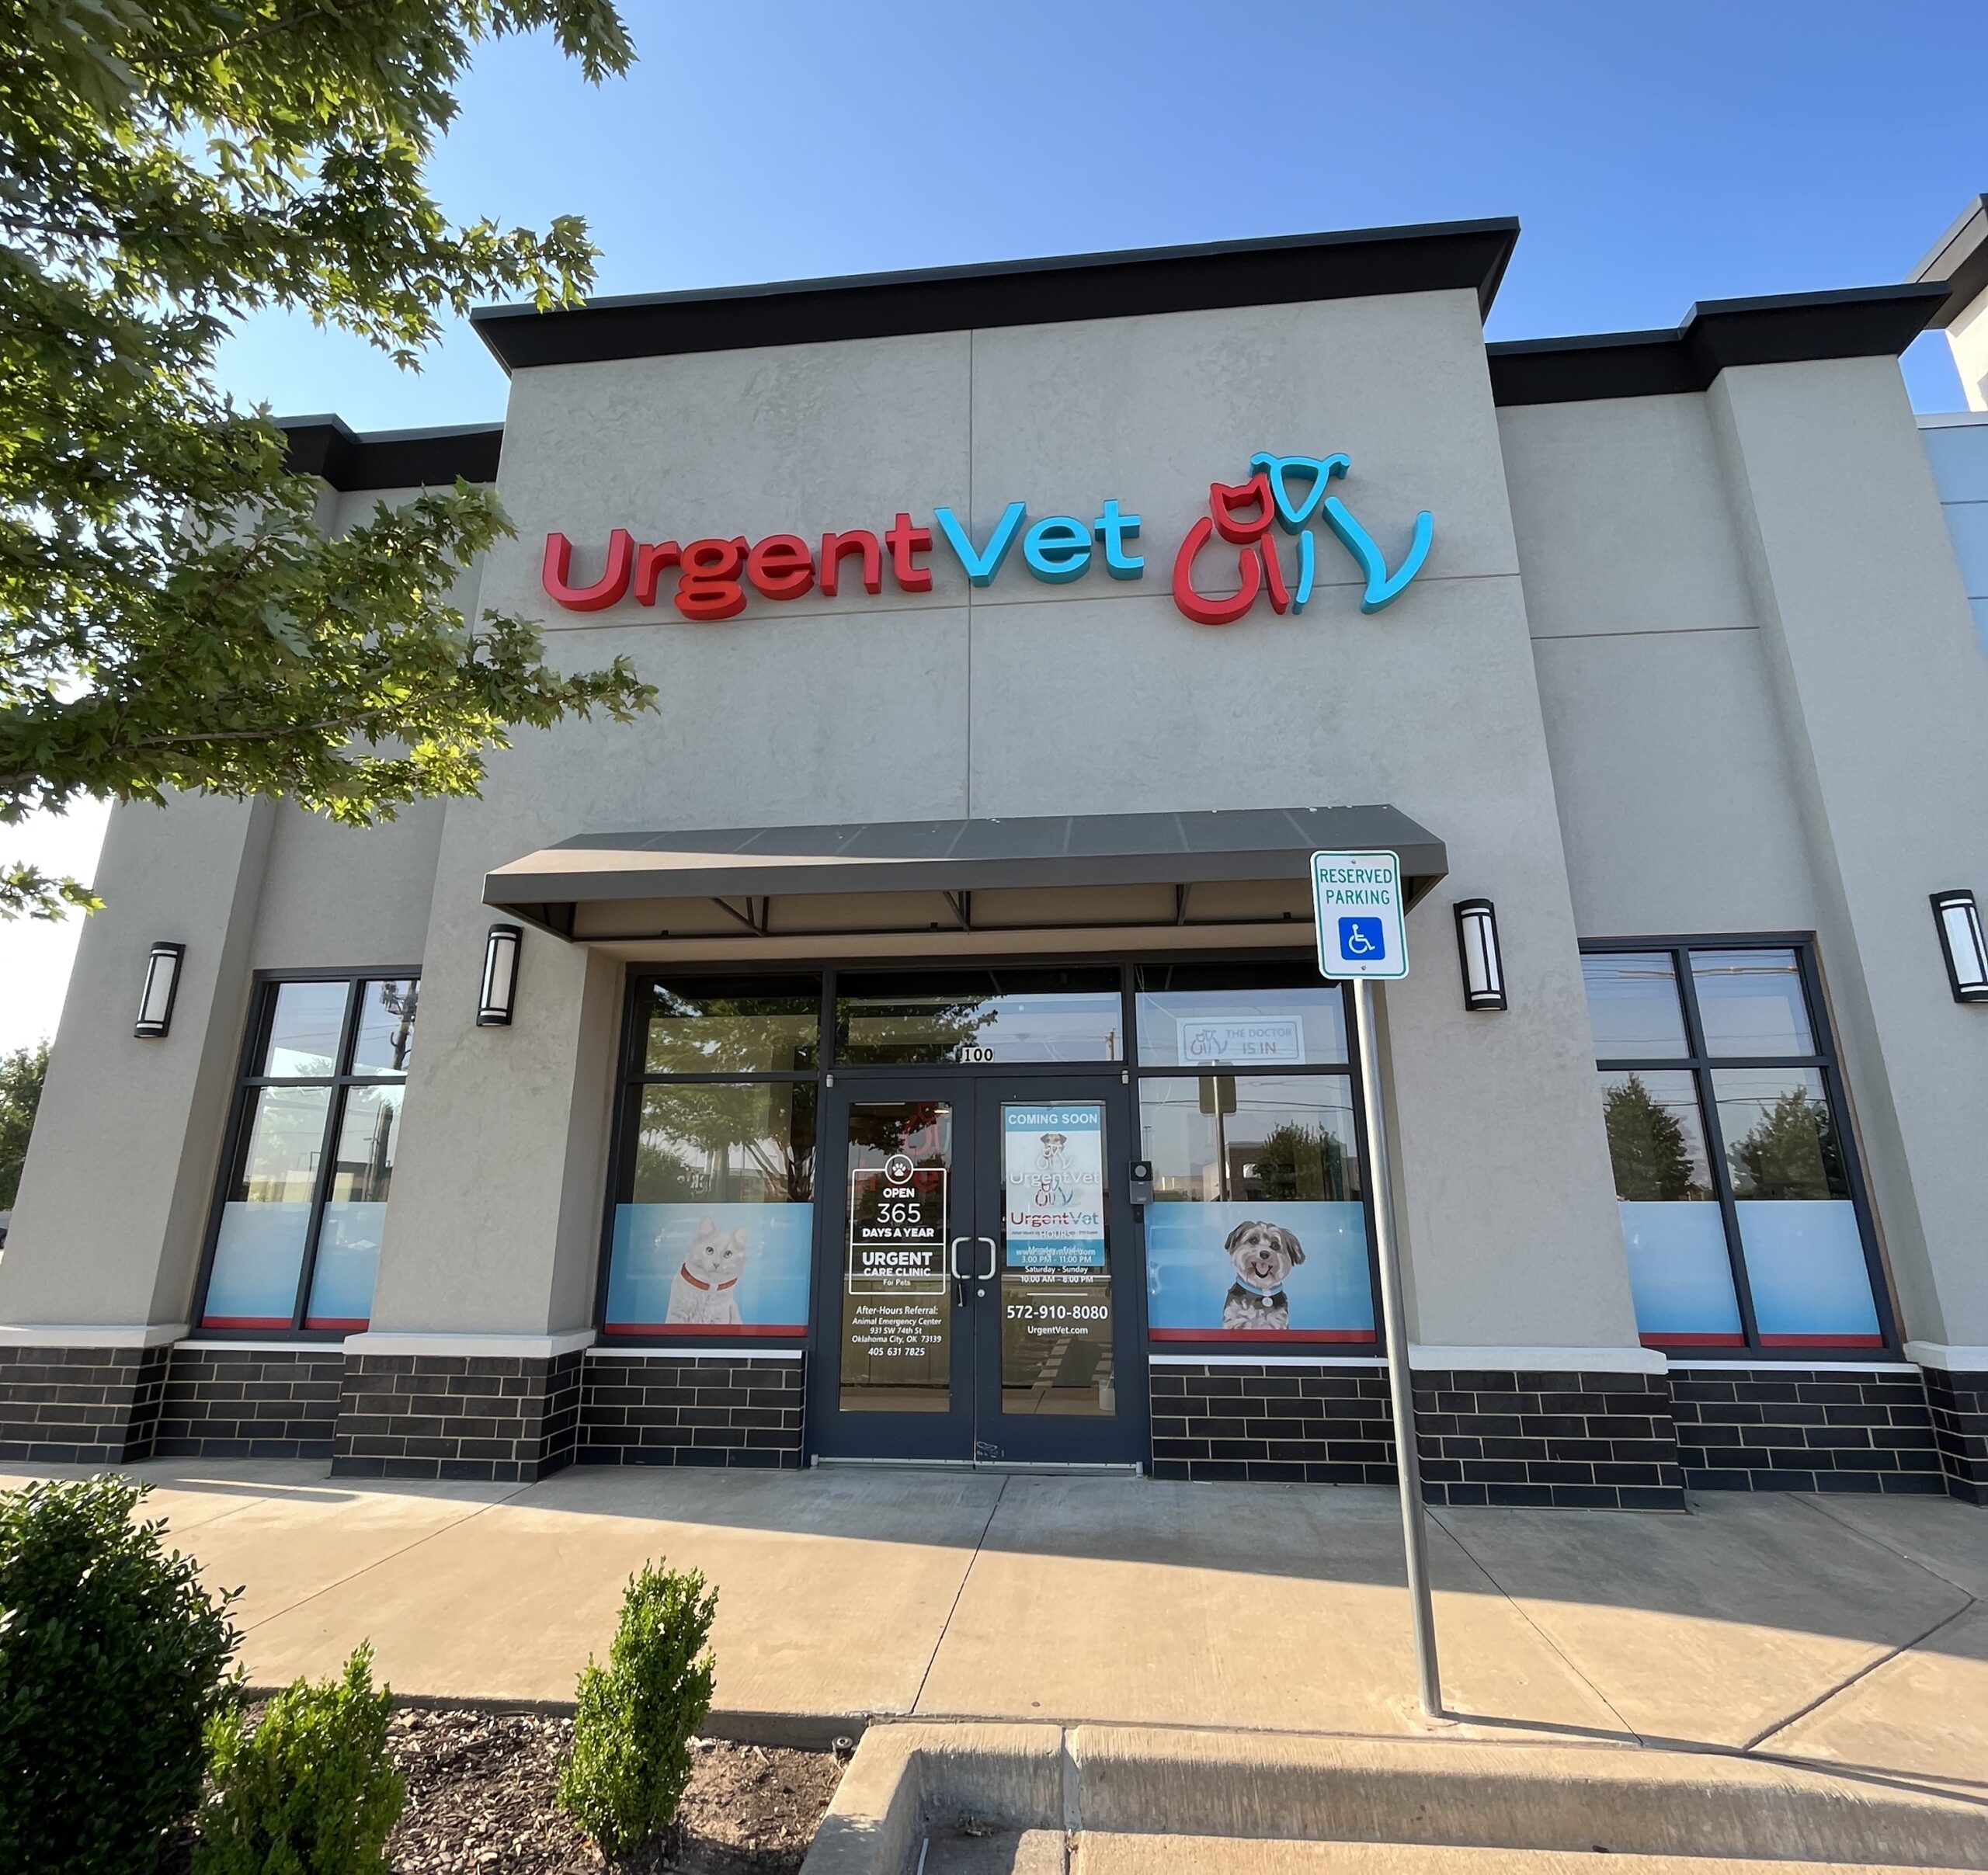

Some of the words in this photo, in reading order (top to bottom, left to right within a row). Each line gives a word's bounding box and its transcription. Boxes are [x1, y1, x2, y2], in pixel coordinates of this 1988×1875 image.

[543, 498, 1144, 620] UrgentVet
[1320, 869, 1392, 884] RESERVED
[1326, 890, 1390, 905] PARKING
[1225, 1030, 1246, 1038] THE
[1249, 1029, 1291, 1037] DOCTOR
[1242, 1043, 1255, 1054] IS
[1260, 1042, 1276, 1054] IN
[964, 1048, 993, 1061] 100
[1009, 1114, 1058, 1125] COMING
[1062, 1113, 1097, 1124] SOON
[1010, 1171, 1100, 1187] UrgentVet
[883, 1188, 915, 1198] OPEN
[877, 1203, 921, 1223] 365
[1011, 1212, 1099, 1227] UrgentVet
[862, 1228, 892, 1238] DAYS
[893, 1228, 902, 1238] A
[903, 1228, 934, 1238] YEAR
[1040, 1231, 1072, 1239] HOURS
[862, 1252, 933, 1266] URGENT
[864, 1268, 893, 1276] CARE
[895, 1268, 931, 1276] CLINIC
[1025, 1266, 1055, 1274] Saturday
[1062, 1266, 1088, 1274] Sunday
[856, 1306, 902, 1314] After-Hours
[904, 1306, 938, 1314] Referral:
[1007, 1306, 1108, 1319] 572-910-8080
[1027, 1326, 1088, 1335] UrgentVet.com
[889, 1335, 905, 1344] City,
